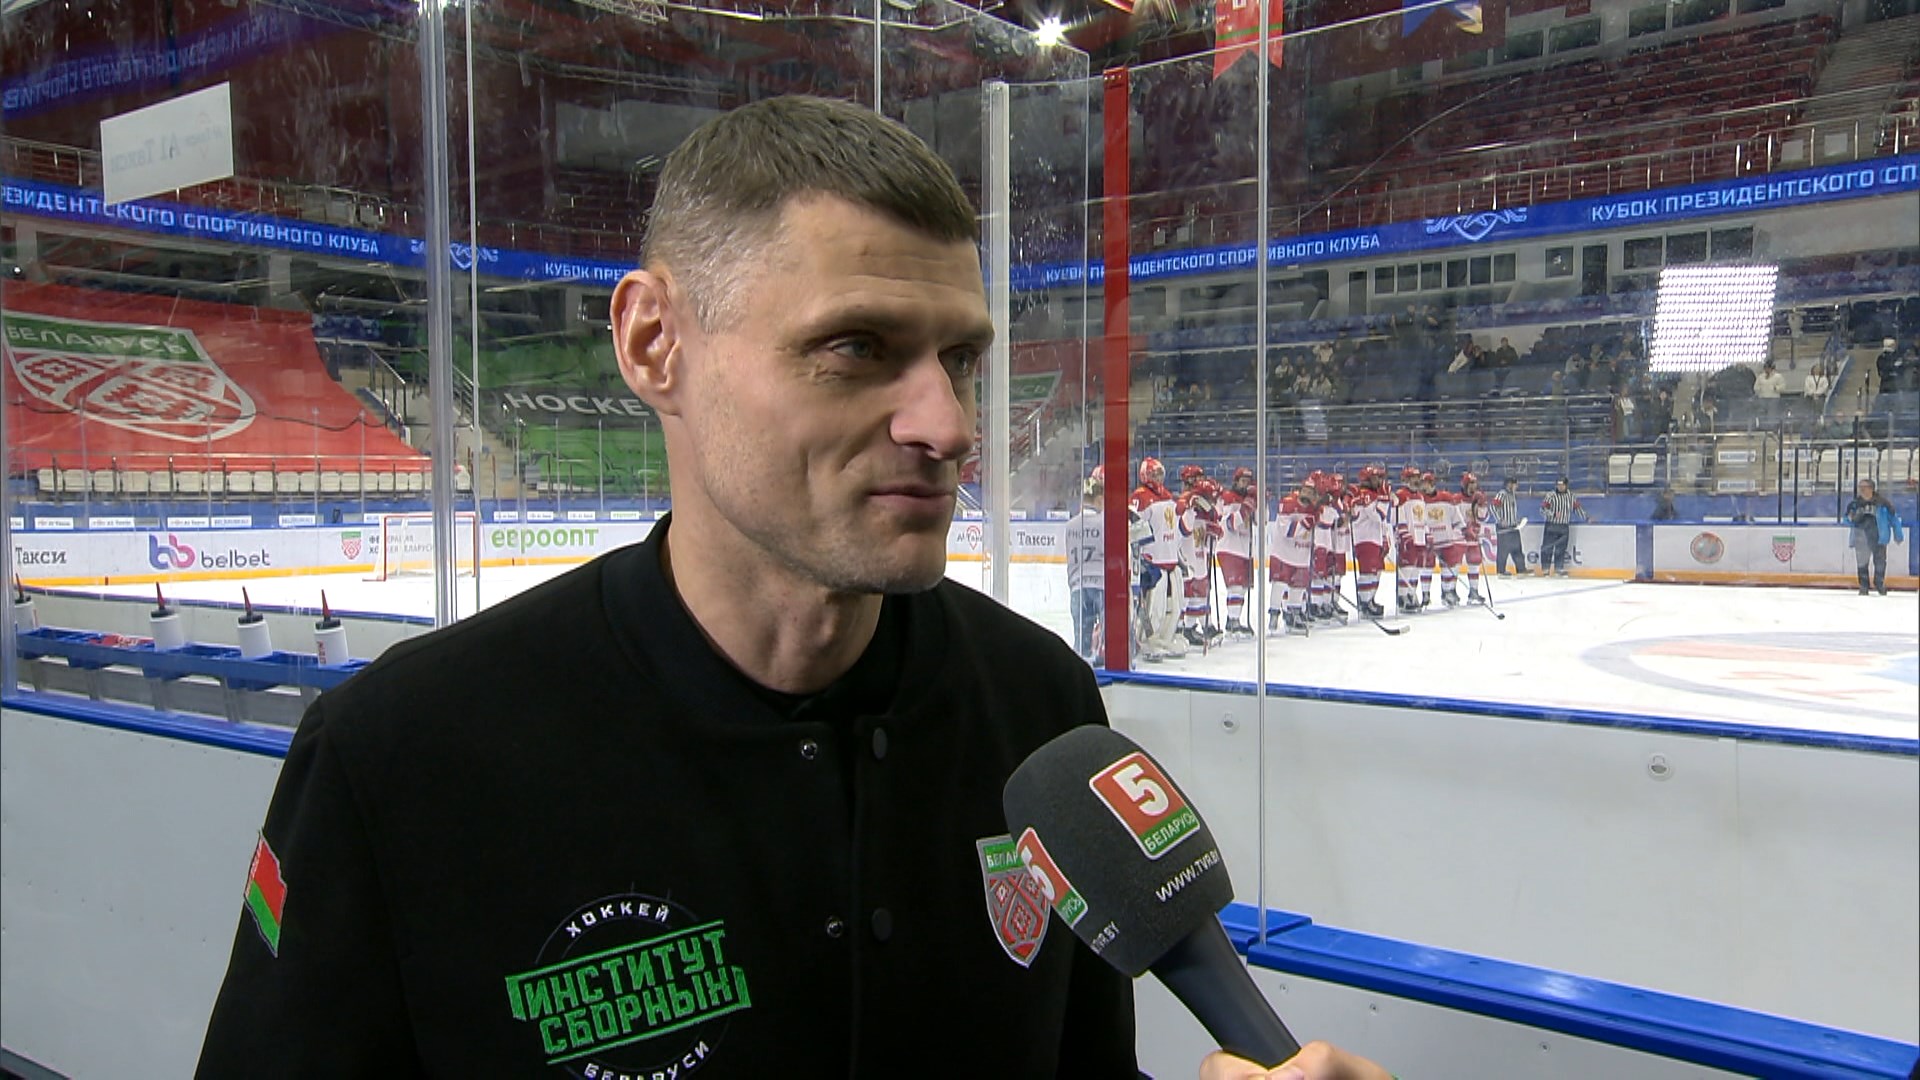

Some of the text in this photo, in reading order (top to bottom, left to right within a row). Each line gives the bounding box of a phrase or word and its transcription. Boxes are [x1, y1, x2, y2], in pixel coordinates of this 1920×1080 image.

[1592, 199, 1657, 222] КУБОК
[1666, 169, 1874, 212] ПРЕЗИДЕНТСКОГО
[184, 212, 323, 247] СПОРТИВНОГО
[329, 233, 379, 255] КЛУБА
[1219, 240, 1324, 266] СПОРИВНОГО
[1329, 233, 1380, 252] КЛУБА
[545, 262, 589, 278] КУБОК
[7, 325, 188, 355] БЕЛАРУСЬ
[491, 528, 599, 553] евроопт
[1016, 531, 1056, 546] Такси
[15, 547, 67, 565] Такси
[201, 549, 271, 568] belbet
[1070, 546, 1096, 564] 17
[1112, 763, 1169, 816] 5
[566, 901, 670, 938] ХОККЕЙ
[524, 929, 725, 1019] ИНСТИТУТ
[539, 967, 733, 1054] СБОРНЫХ
